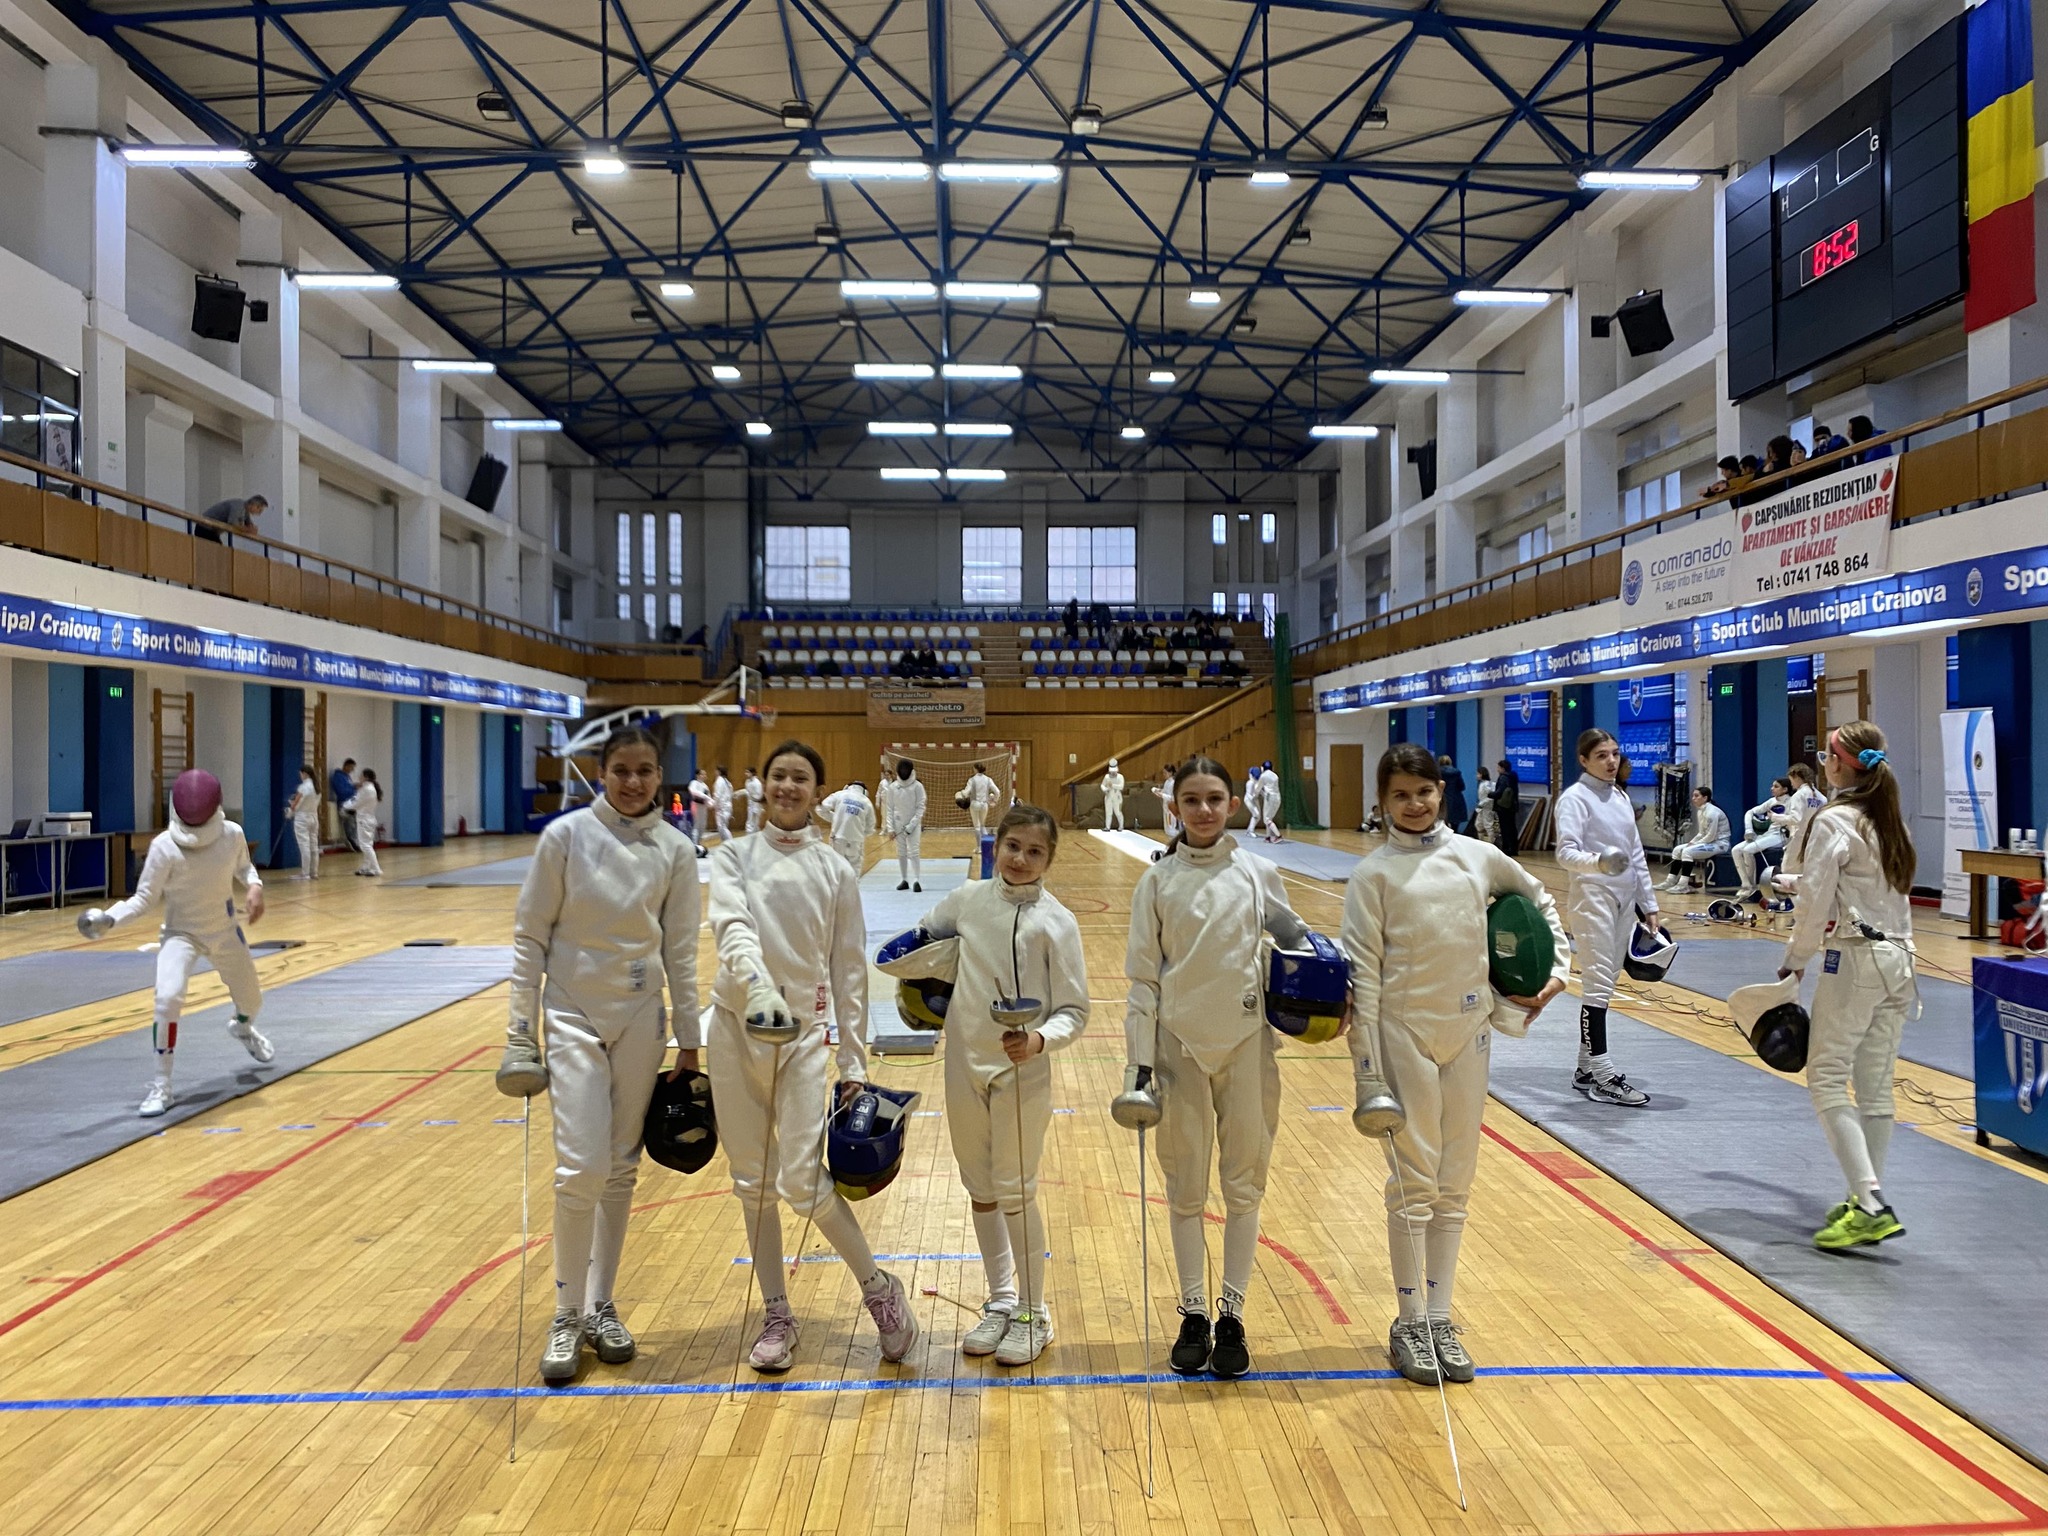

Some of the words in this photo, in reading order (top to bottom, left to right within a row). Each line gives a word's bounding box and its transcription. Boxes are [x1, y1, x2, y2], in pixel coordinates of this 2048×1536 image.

[1869, 134, 1880, 152] G
[1781, 195, 1789, 212] H
[1813, 221, 1858, 277] 8:52
[1742, 518, 1807, 553] APARTAMENTE
[1824, 494, 1891, 532] GARSONIERE
[1651, 537, 1732, 577] comranado
[1780, 548, 1792, 568] DE
[1794, 536, 1838, 564] VÂNZARE
[1662, 577, 1676, 592] step
[1704, 565, 1726, 581] future
[1783, 566, 1811, 587] 0741
[1815, 560, 1840, 580] 748
[1844, 553, 1870, 573] 864
[2004, 564, 2048, 595] Spo
[0, 605, 35, 634] ipal
[40, 612, 102, 642] Craiova
[1711, 618, 1748, 644] Sport
[1751, 611, 1783, 635] Club
[1787, 594, 1866, 628] Municipal
[1872, 583, 1947, 613] Craiova
[132, 626, 170, 653] Sport
[174, 634, 201, 656] Club
[204, 639, 257, 667] Municipal
[259, 647, 298, 671] Craiova
[1547, 655, 1571, 673] Sport
[1571, 648, 1591, 666] Club
[1592, 638, 1638, 661] Municipal
[1641, 633, 1682, 654] Craiova
[315, 657, 338, 678] Sport
[340, 661, 358, 679] Club
[359, 664, 395, 687] Municipal
[396, 670, 420, 688] Craiova
[1440, 674, 1457, 689] Sport
[1457, 671, 1471, 684] Club
[1471, 665, 1503, 683] Municipal
[1503, 661, 1530, 677] Craiova
[1787, 678, 1808, 689] aiova
[890, 703, 962, 712] www.peparchet.ro
[1706, 859, 1716, 886] 2
[1582, 1007, 1593, 1054] ARMO
[2003, 1015, 2048, 1040] UNIVERSITAT
